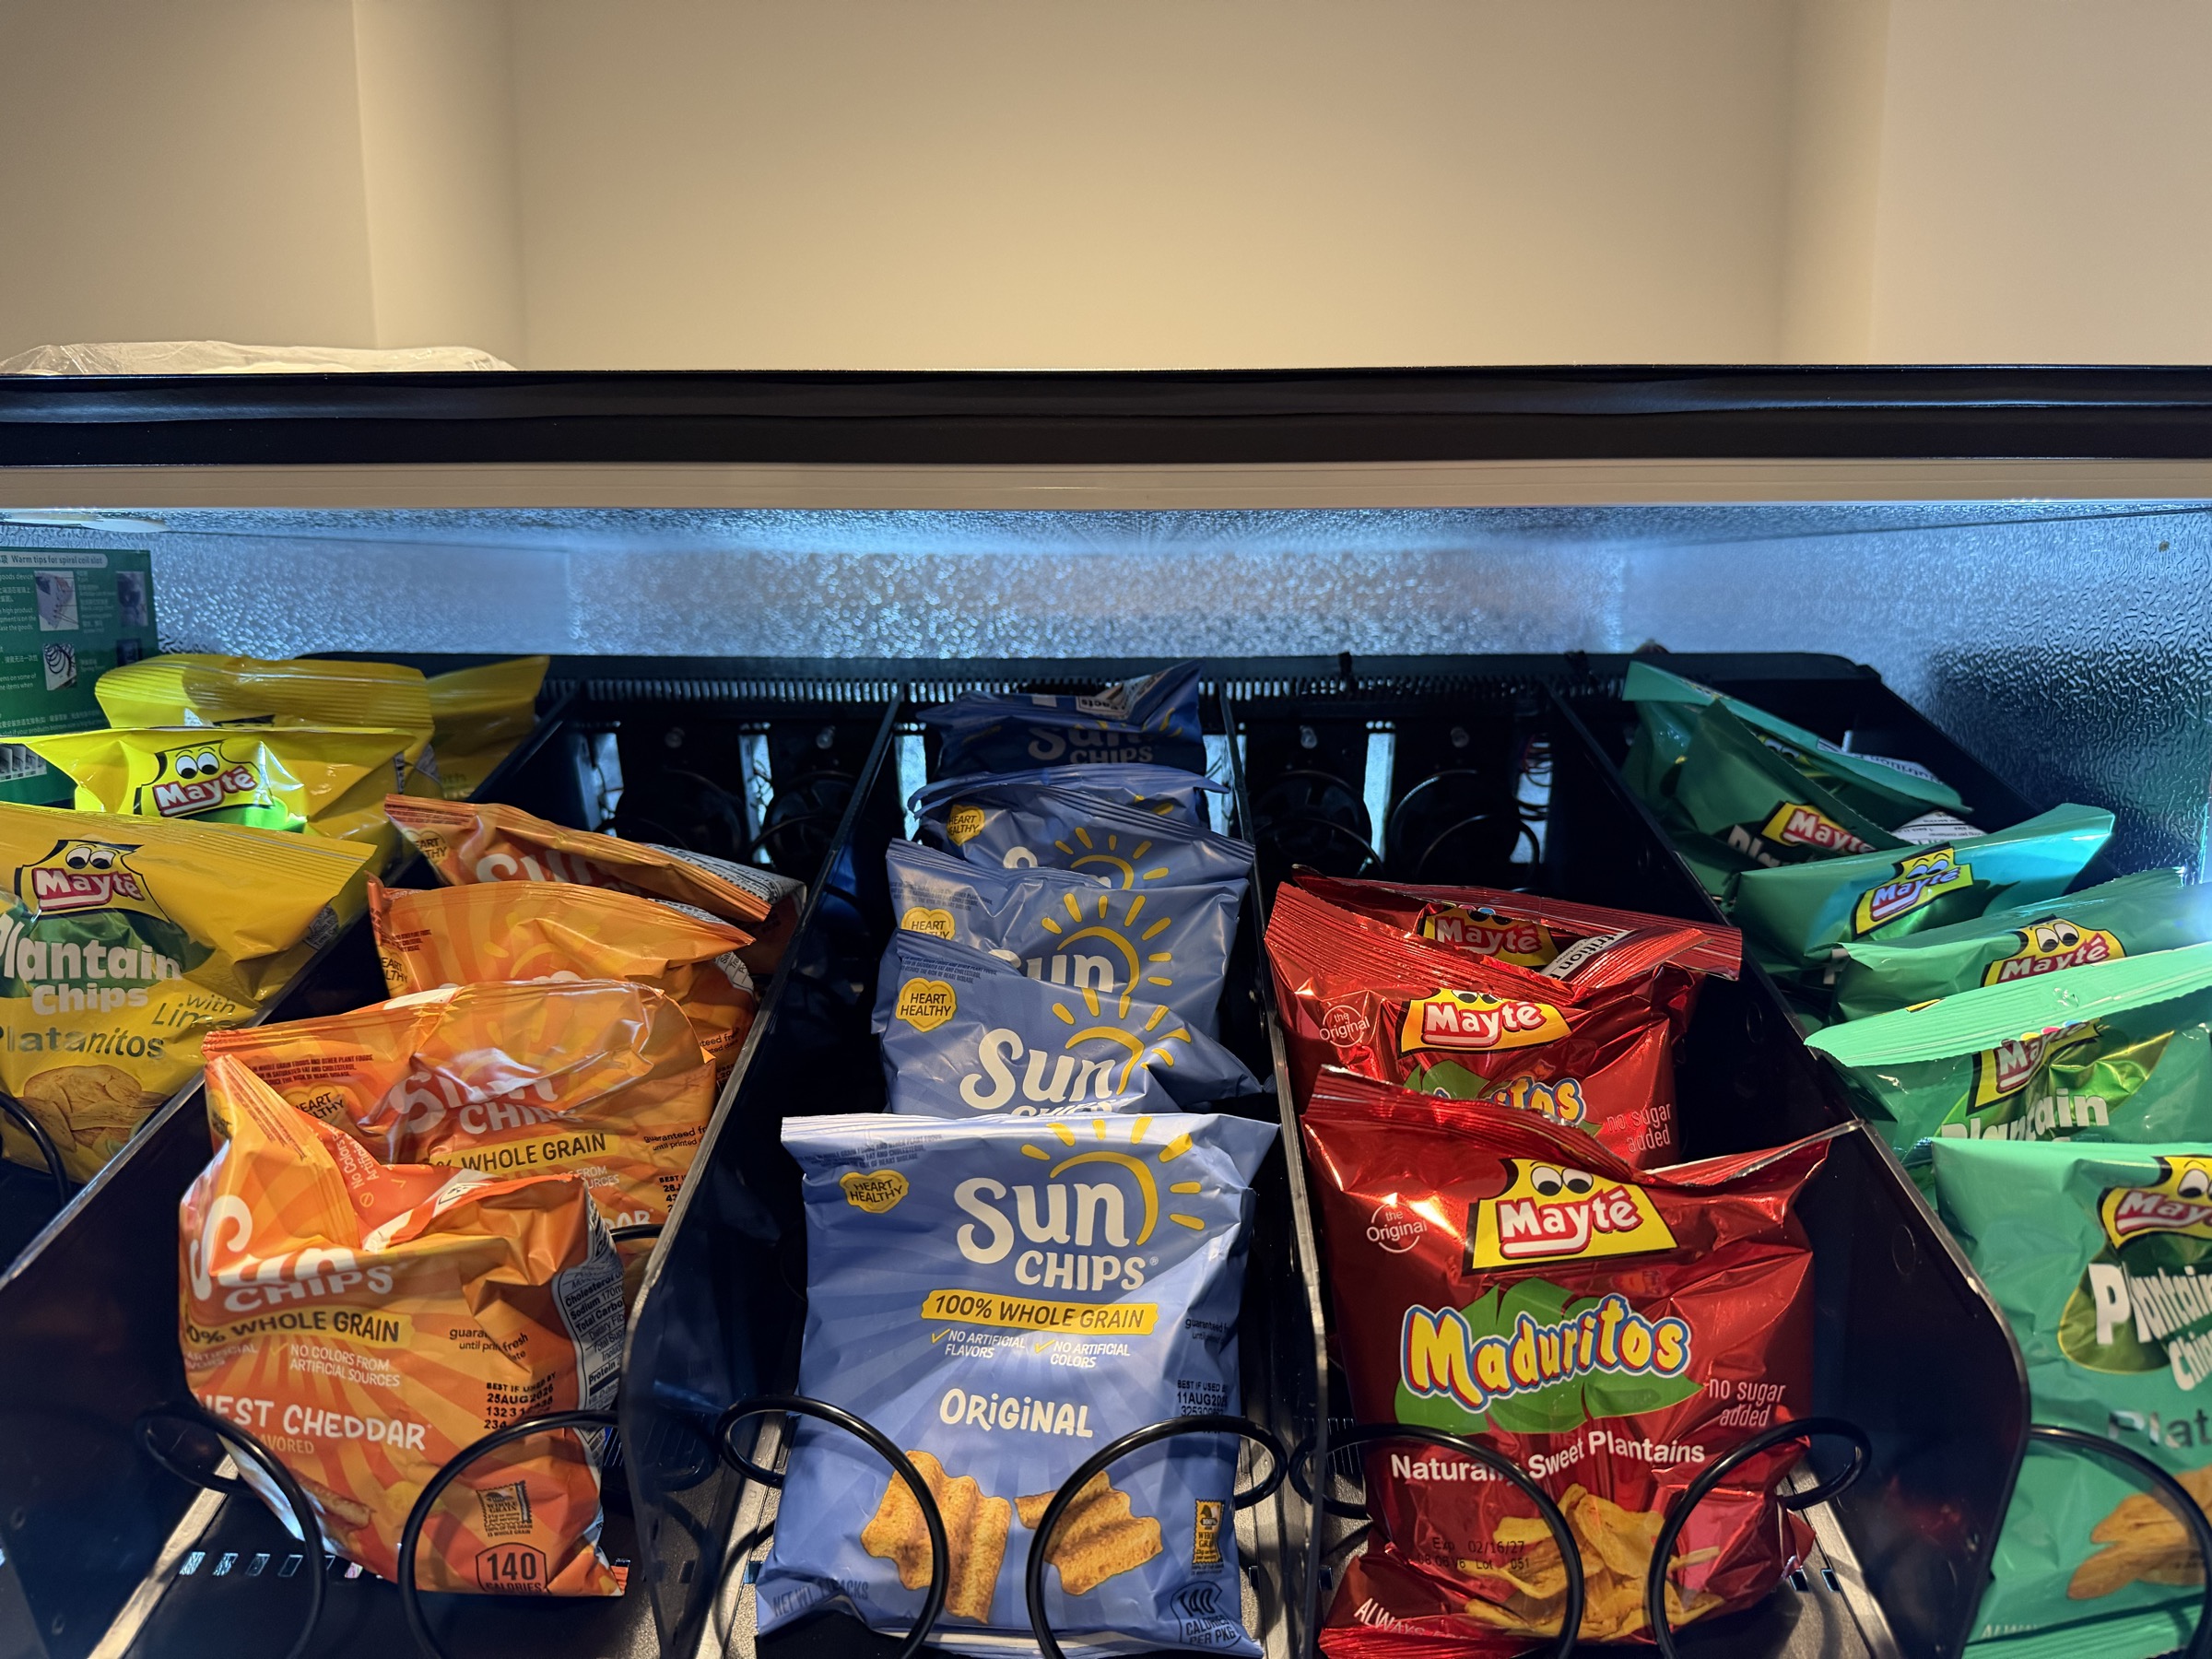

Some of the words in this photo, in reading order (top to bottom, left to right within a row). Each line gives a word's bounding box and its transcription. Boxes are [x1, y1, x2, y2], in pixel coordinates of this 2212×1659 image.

[11, 555, 32, 563] Warm
[33, 555, 47, 565] tips
[48, 555, 57, 563] for
[59, 555, 77, 565] spiral
[78, 556, 89, 564] coil
[1069, 745, 1154, 764] CHIPS
[155, 768, 256, 815] Mayté
[948, 815, 977, 826] HEART
[35, 869, 146, 910] Mayté
[911, 920, 947, 930] HEART
[1437, 919, 1541, 955] Mayté
[2000, 933, 2110, 982] Mayté
[187, 993, 237, 1015] with
[900, 1005, 951, 1017] HEALTHY
[911, 993, 947, 1005] HEART
[1319, 1016, 1371, 1041] Original
[1334, 1012, 1349, 1023] the
[1424, 1001, 1547, 1046] Mayté
[959, 1029, 1113, 1110] Sun
[1606, 1114, 1626, 1132] no
[1632, 1103, 1672, 1127] sugar
[643, 1129, 696, 1144] guaranteed
[670, 1139, 697, 1149] printed
[1626, 1124, 1671, 1153] added
[461, 1145, 538, 1171] WHOLE
[542, 1133, 606, 1161] GRAIN
[659, 1175, 679, 1183] BEST
[853, 1179, 893, 1192] HEART
[850, 1184, 902, 1203] HEALTHY
[953, 1177, 1130, 1265] Sun
[1384, 1209, 1404, 1220] the
[1500, 1190, 1640, 1254] Mayté
[1366, 1217, 1428, 1244] Original
[1015, 1250, 1145, 1291] CHIPS
[224, 1265, 394, 1312] CHIPS
[565, 1274, 616, 1307] Cholesterol
[571, 1297, 601, 1321] Sodium
[935, 1294, 993, 1319] 100%
[999, 1300, 1077, 1326] WHOLE
[1079, 1309, 1145, 1328] GRAIN
[232, 1312, 327, 1336] WHOLE
[334, 1311, 399, 1342] GRAIN
[575, 1312, 596, 1334] Total
[459, 1340, 481, 1349] until
[502, 1332, 528, 1351] fresh
[594, 1338, 609, 1353] Total
[945, 1343, 994, 1359] FLAVORS
[948, 1330, 966, 1342] NO
[967, 1333, 1026, 1348] ARTIFICIAL
[1053, 1341, 1073, 1353] NO
[1074, 1342, 1131, 1357] ARTIFICIAL
[290, 1344, 309, 1359] NO
[312, 1347, 355, 1365] COLORS
[357, 1356, 391, 1371] FROM
[1050, 1354, 1096, 1368] COLORS
[1403, 1295, 1688, 1411] Maduritos
[289, 1359, 347, 1380] ARTIFICIAL
[347, 1369, 400, 1387] SOURCES
[589, 1360, 616, 1383] Protein
[487, 1382, 508, 1392] BEST
[1177, 1379, 1194, 1389] BEST
[1195, 1382, 1201, 1390] IF
[1203, 1382, 1220, 1392] USED
[1708, 1378, 1731, 1399] no
[1736, 1380, 1786, 1405] sugar
[1719, 1403, 1769, 1428] added
[283, 1404, 426, 1452] CHEDDAR
[1528, 1439, 1585, 1479] Sweet
[1588, 1430, 1705, 1464] Plantains
[1433, 1537, 1455, 1553] Exp
[1468, 1540, 1525, 1555] 02/16/27
[487, 1552, 536, 1581] 140
[1476, 1559, 1493, 1570] Lot
[1511, 1558, 1530, 1570] 051
[772, 1591, 794, 1618] NET
[1178, 1588, 1216, 1618] 140
[1185, 1614, 1230, 1636] CALORIES
[1354, 1597, 1426, 1637] ALWAYS
[1189, 1632, 1212, 1644] PER
[1215, 1627, 1236, 1643] PKG
